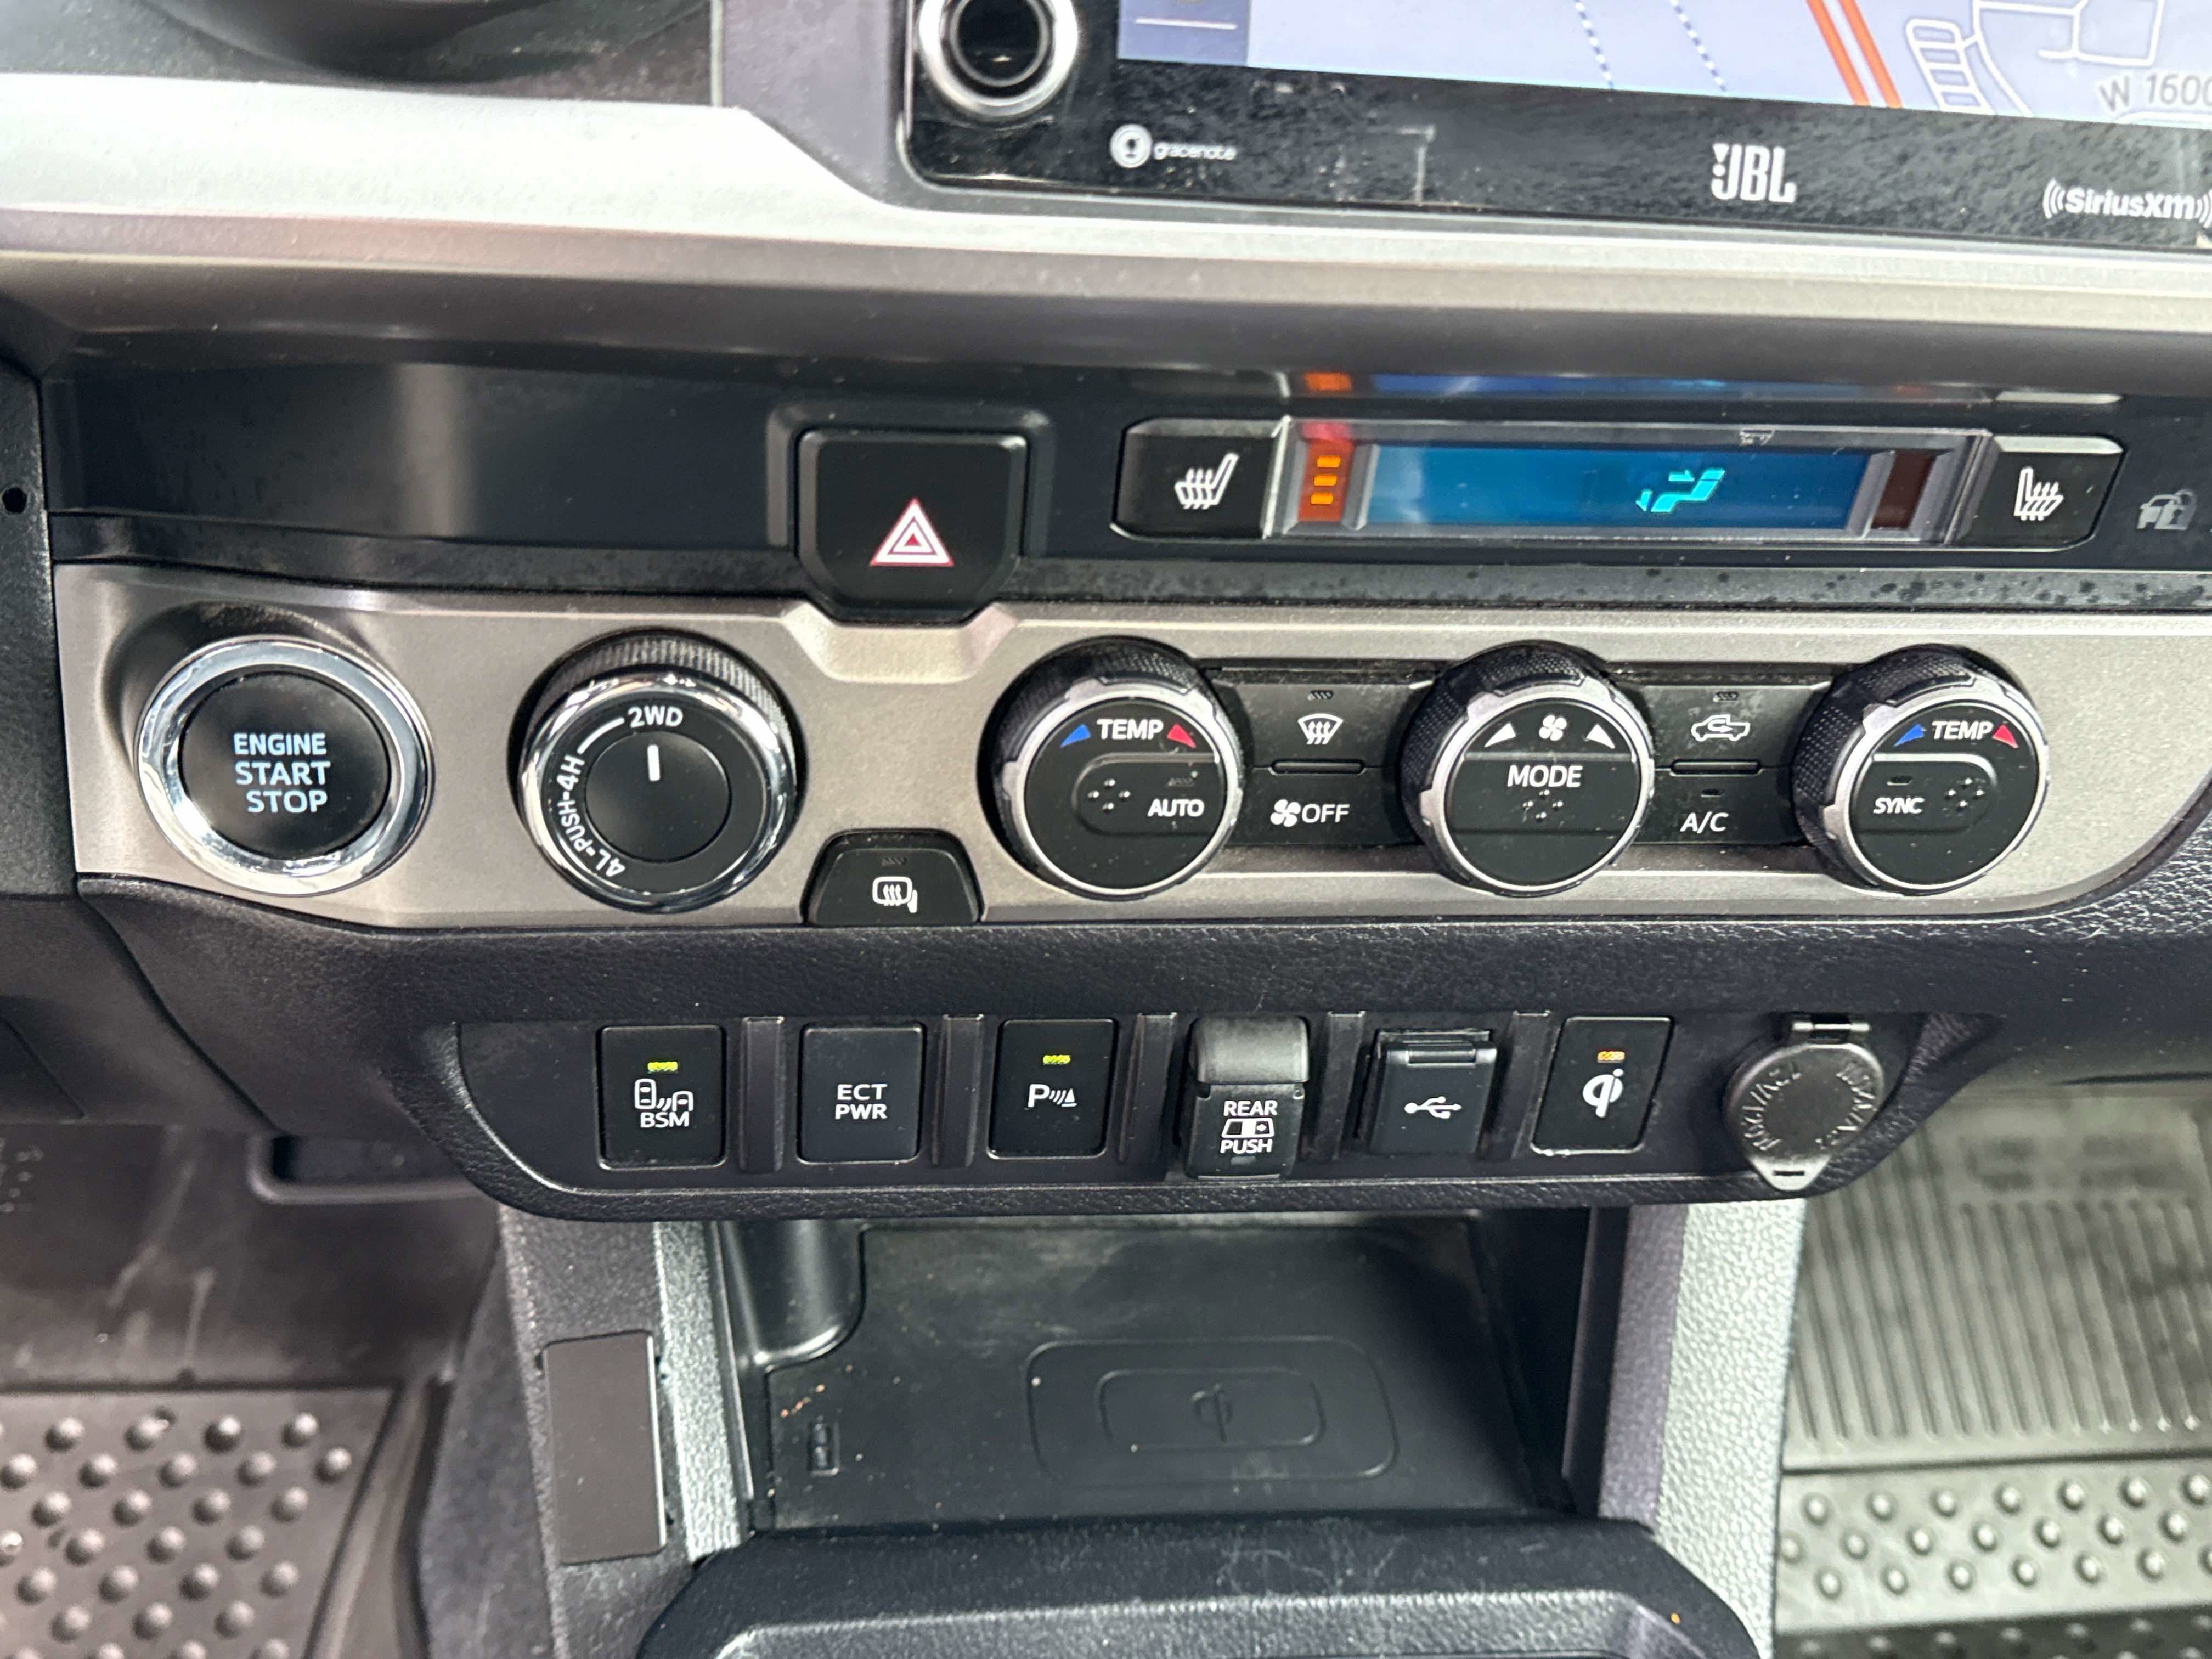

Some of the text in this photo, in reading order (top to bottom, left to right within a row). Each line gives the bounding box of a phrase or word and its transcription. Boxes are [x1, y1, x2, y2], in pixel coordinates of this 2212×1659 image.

[2098, 75, 2130, 111] W
[1711, 143, 1797, 204] JBL
[628, 705, 684, 728] 2WD
[1096, 719, 1164, 740] TEMP
[1932, 720, 1992, 740] TEMP
[234, 732, 327, 756] ENGINE
[235, 761, 331, 786] START
[1507, 764, 1583, 788] MODE
[246, 789, 328, 813] STOP
[1147, 798, 1205, 817] AUTO
[1873, 797, 1925, 814] SYNC
[1301, 803, 1350, 823] OFF
[1680, 811, 1729, 834] A/C
[837, 1084, 888, 1101] ECT
[835, 1103, 887, 1120] PWR
[1223, 1099, 1278, 1116] REAR
[640, 1110, 690, 1128] BSM
[1220, 1135, 1274, 1154] PUSH
